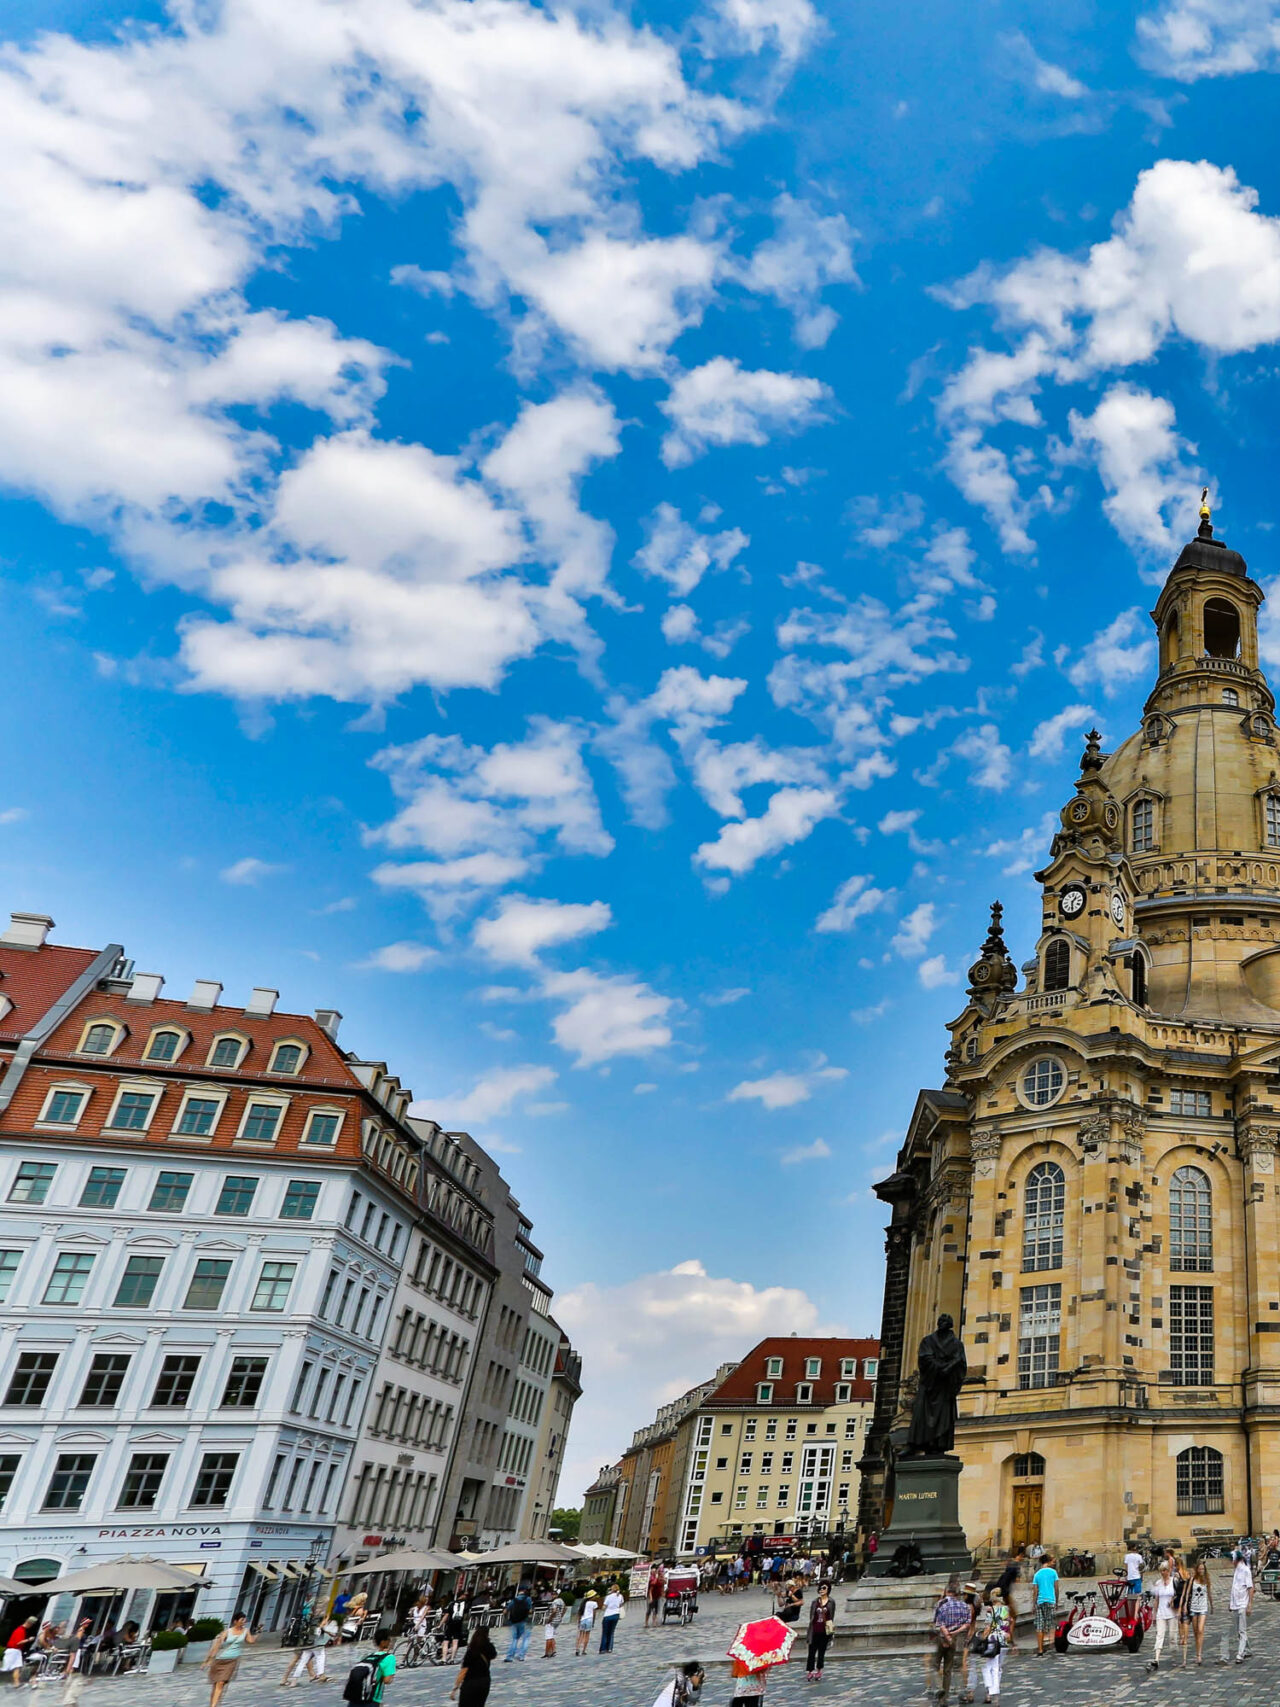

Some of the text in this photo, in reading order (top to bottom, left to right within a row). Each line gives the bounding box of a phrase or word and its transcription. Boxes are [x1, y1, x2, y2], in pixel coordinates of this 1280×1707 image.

[98, 1527, 221, 1538] PIAZZA NOVA
[256, 1526, 288, 1535] PIAZZA NOVA
